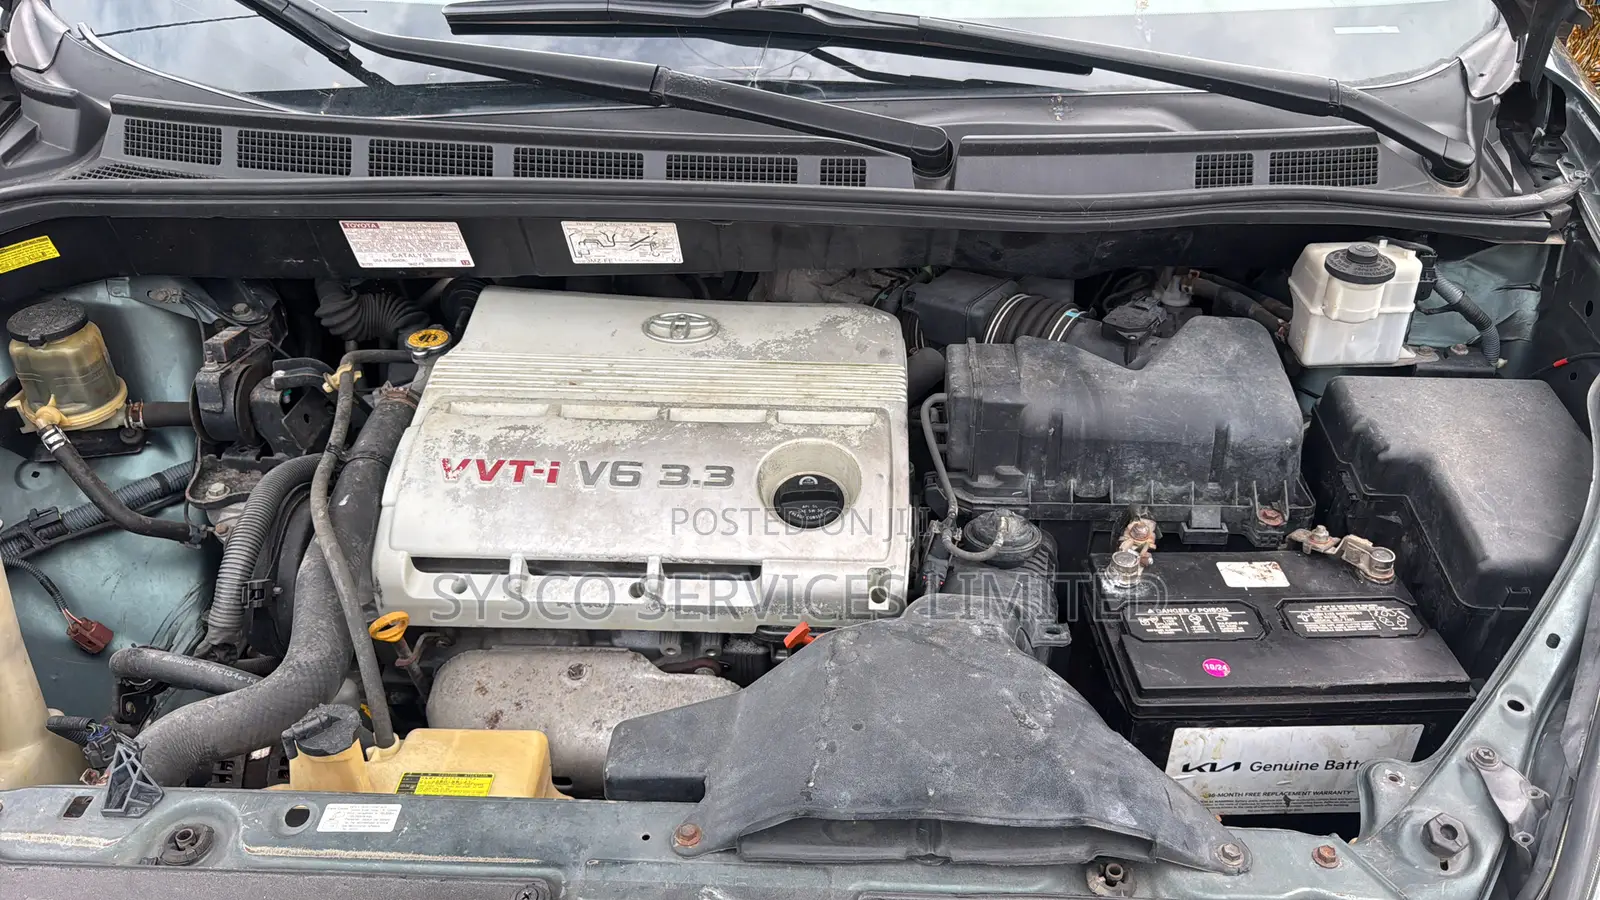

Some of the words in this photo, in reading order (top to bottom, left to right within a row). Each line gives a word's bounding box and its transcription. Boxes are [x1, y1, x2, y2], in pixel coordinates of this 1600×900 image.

[440, 457, 561, 484] VVT-i
[577, 460, 643, 487] V6
[658, 464, 735, 487] 3.3
[1250, 760, 1319, 772] Genuine
[1324, 760, 1362, 771] Batt
